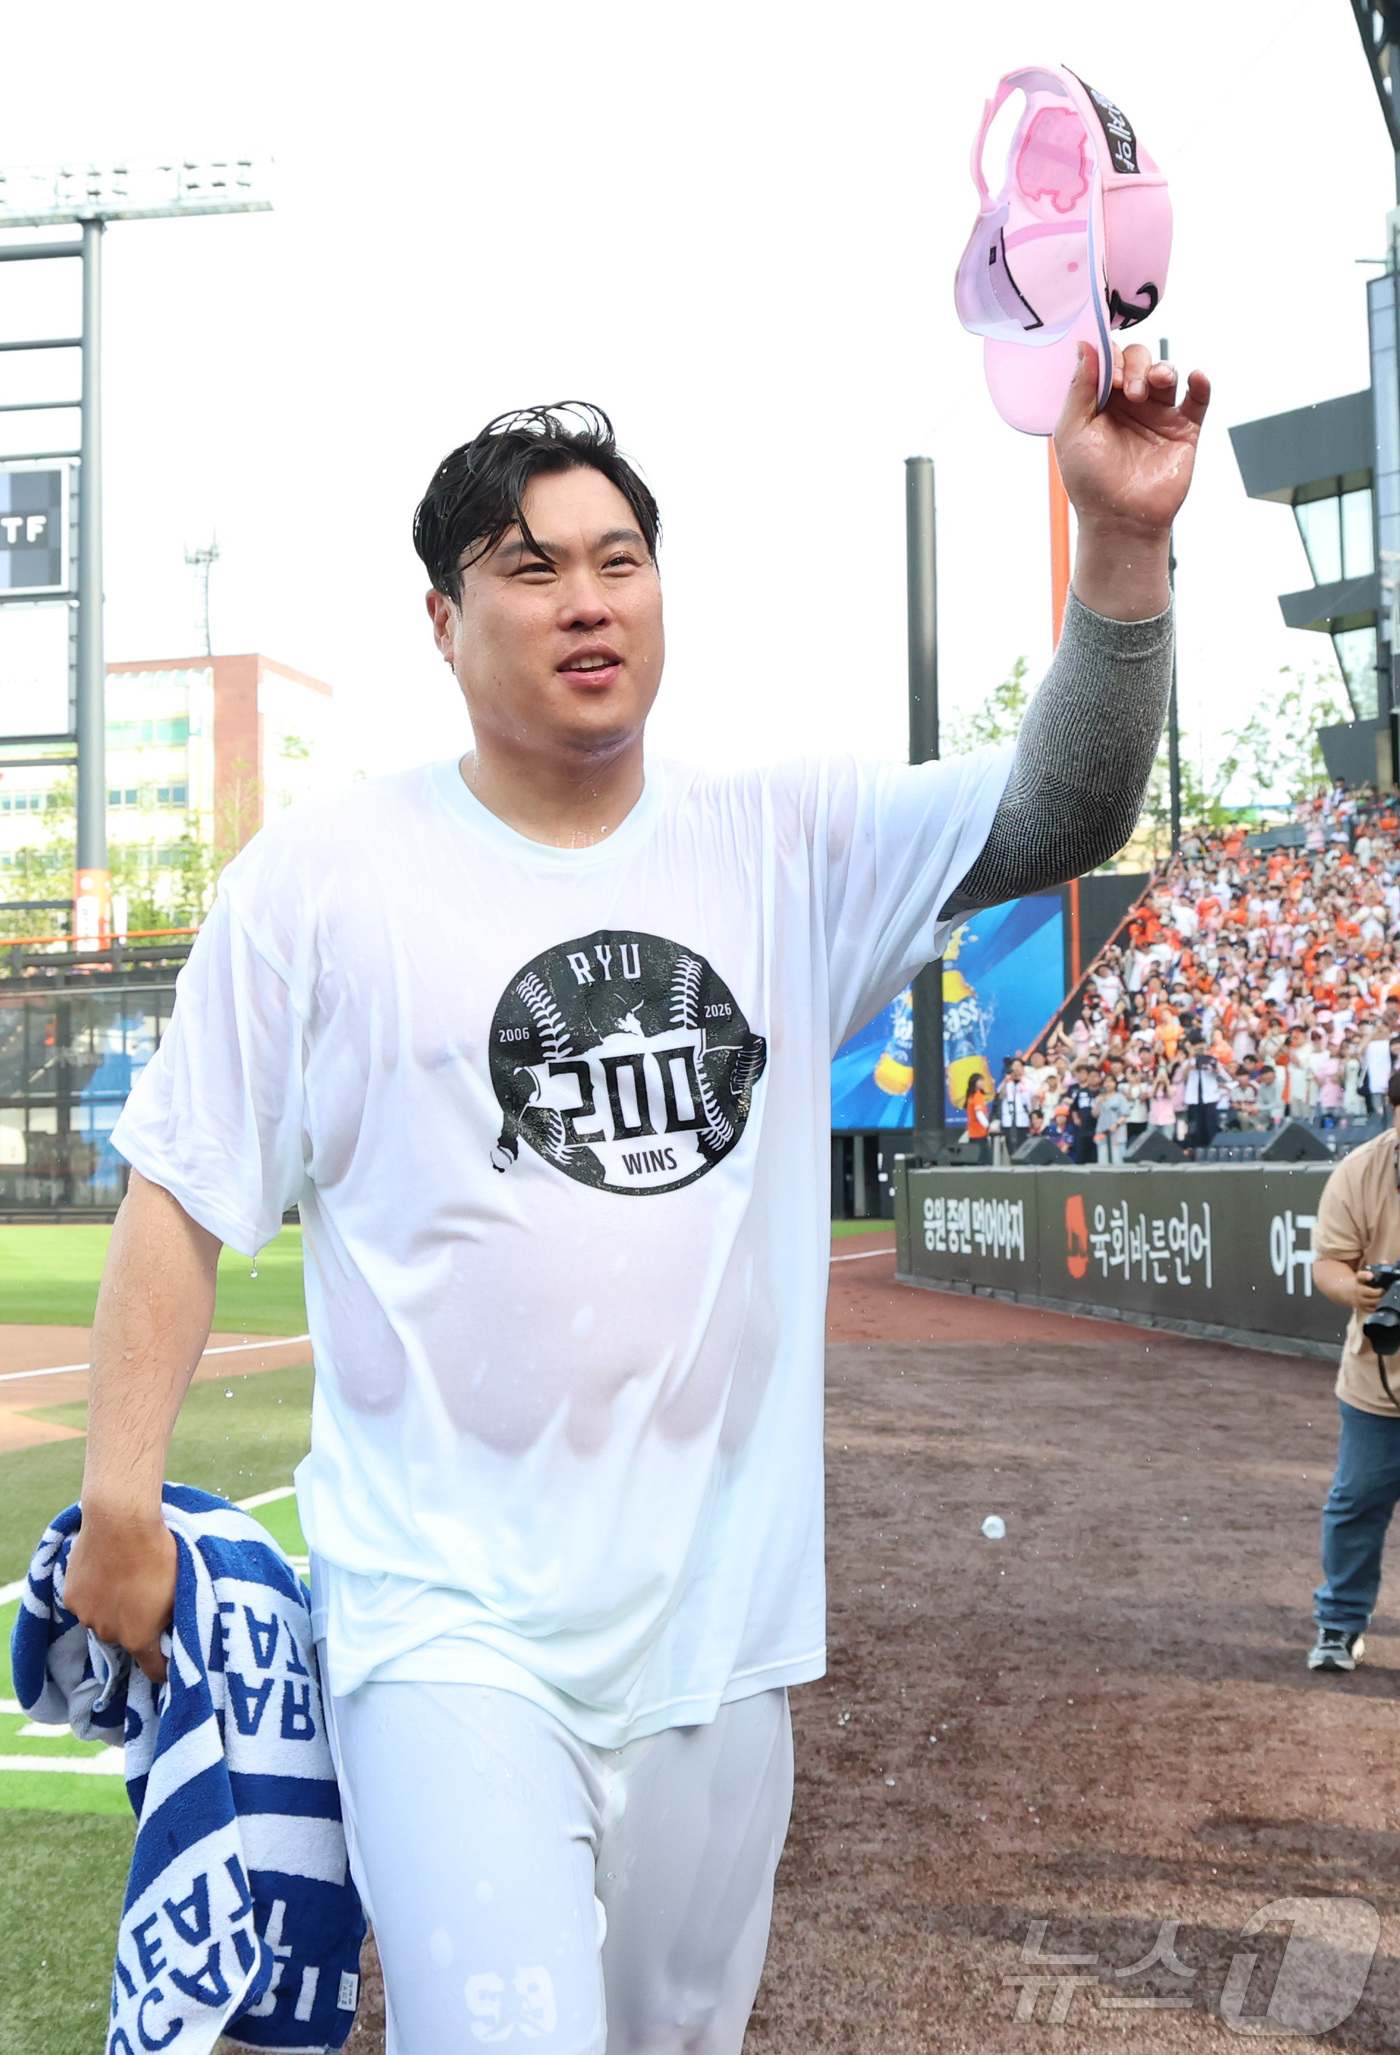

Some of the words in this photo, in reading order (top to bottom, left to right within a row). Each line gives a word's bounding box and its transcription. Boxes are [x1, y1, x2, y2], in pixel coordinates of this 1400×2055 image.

[1, 515, 47, 543] TF
[566, 943, 642, 985] RYU
[703, 1003, 732, 1019] 2026
[499, 1027, 530, 1043] 2006
[548, 1045, 711, 1145] 200
[622, 1148, 678, 1176] WINS
[923, 1197, 947, 1252] 응원
[946, 1197, 972, 1254] 중엔
[972, 1197, 1025, 1262] 먹어야지
[1089, 1199, 1212, 1289] 육회바른연어
